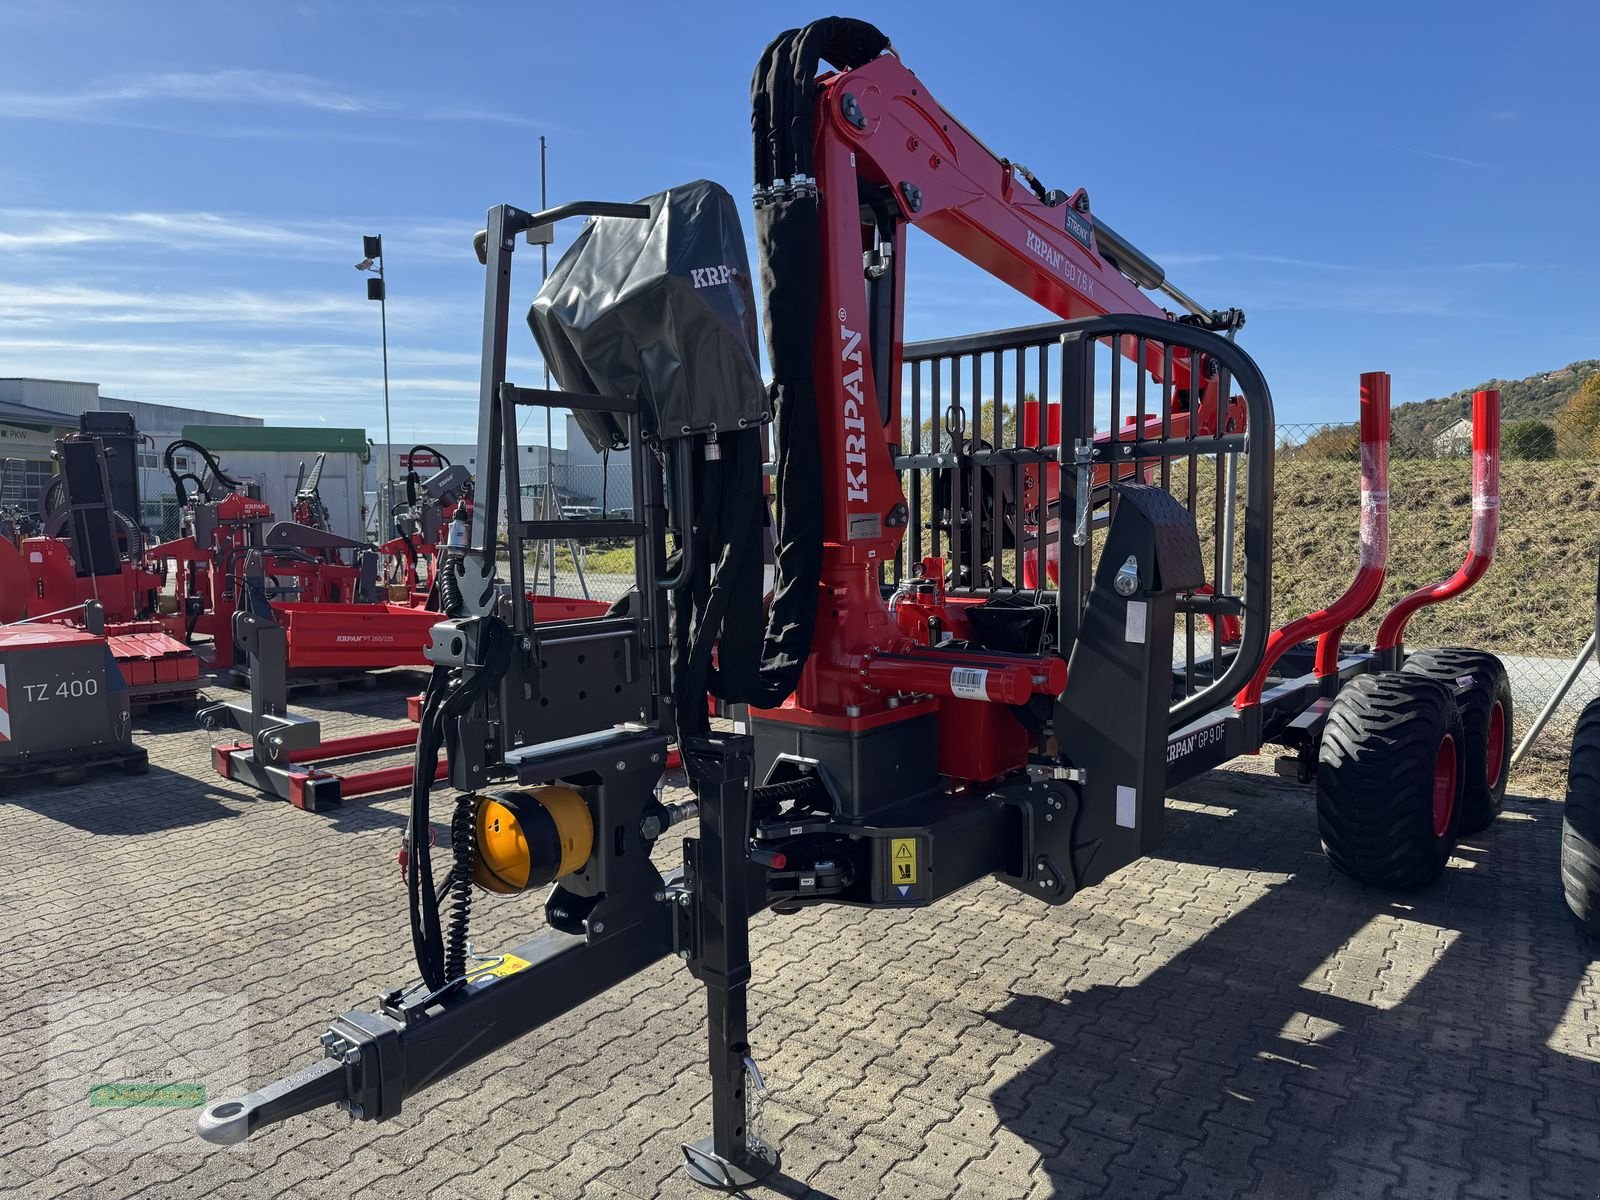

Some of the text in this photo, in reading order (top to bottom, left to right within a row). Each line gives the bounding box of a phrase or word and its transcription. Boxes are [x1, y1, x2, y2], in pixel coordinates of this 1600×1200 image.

[1066, 217, 1087, 240] STRENX
[1065, 261, 1075, 281] GD
[10, 431, 27, 439] PKW
[22, 679, 98, 702] TZ 400
[1198, 730, 1209, 749] GP
[1209, 727, 1215, 743] 9
[1215, 723, 1225, 742] DF
